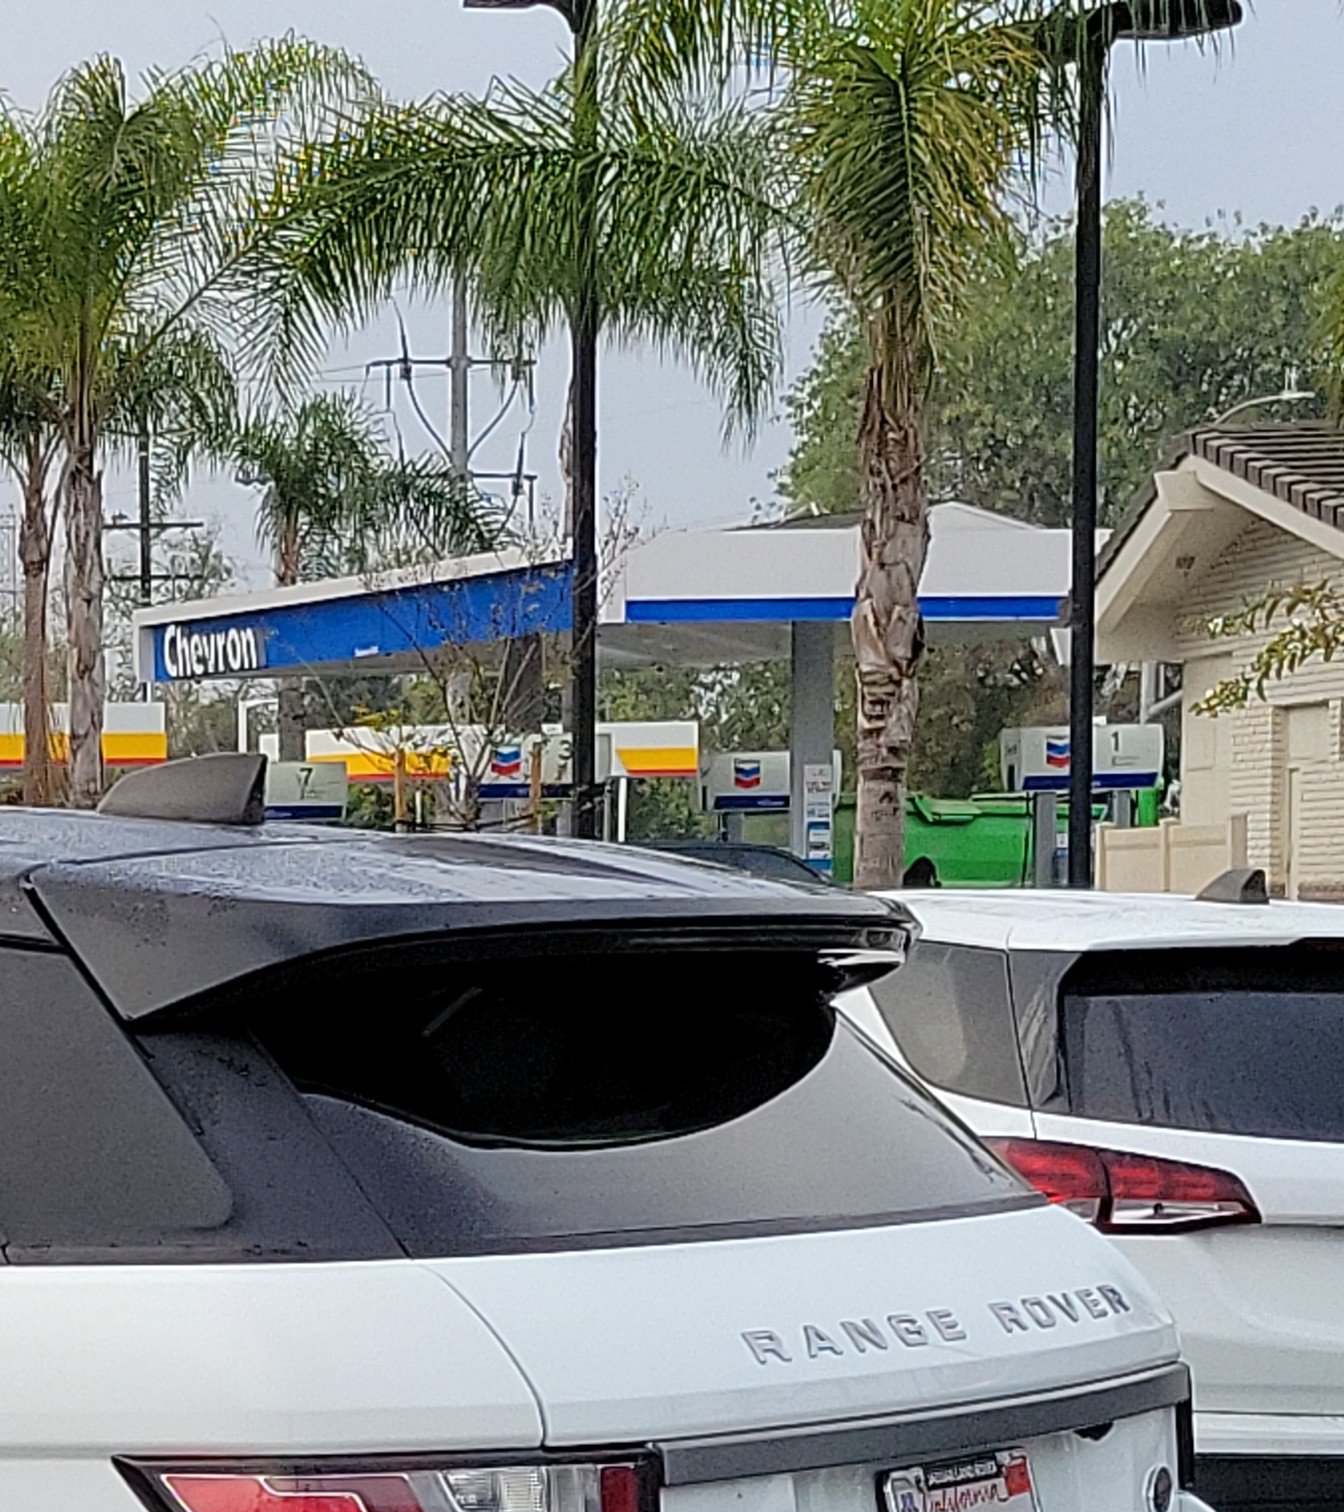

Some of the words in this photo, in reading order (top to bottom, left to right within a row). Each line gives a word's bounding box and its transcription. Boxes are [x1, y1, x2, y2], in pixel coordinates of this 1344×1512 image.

[163, 624, 258, 678] Chevron
[740, 1307, 968, 1366] RANGE
[986, 1283, 1132, 1335] ROVER
